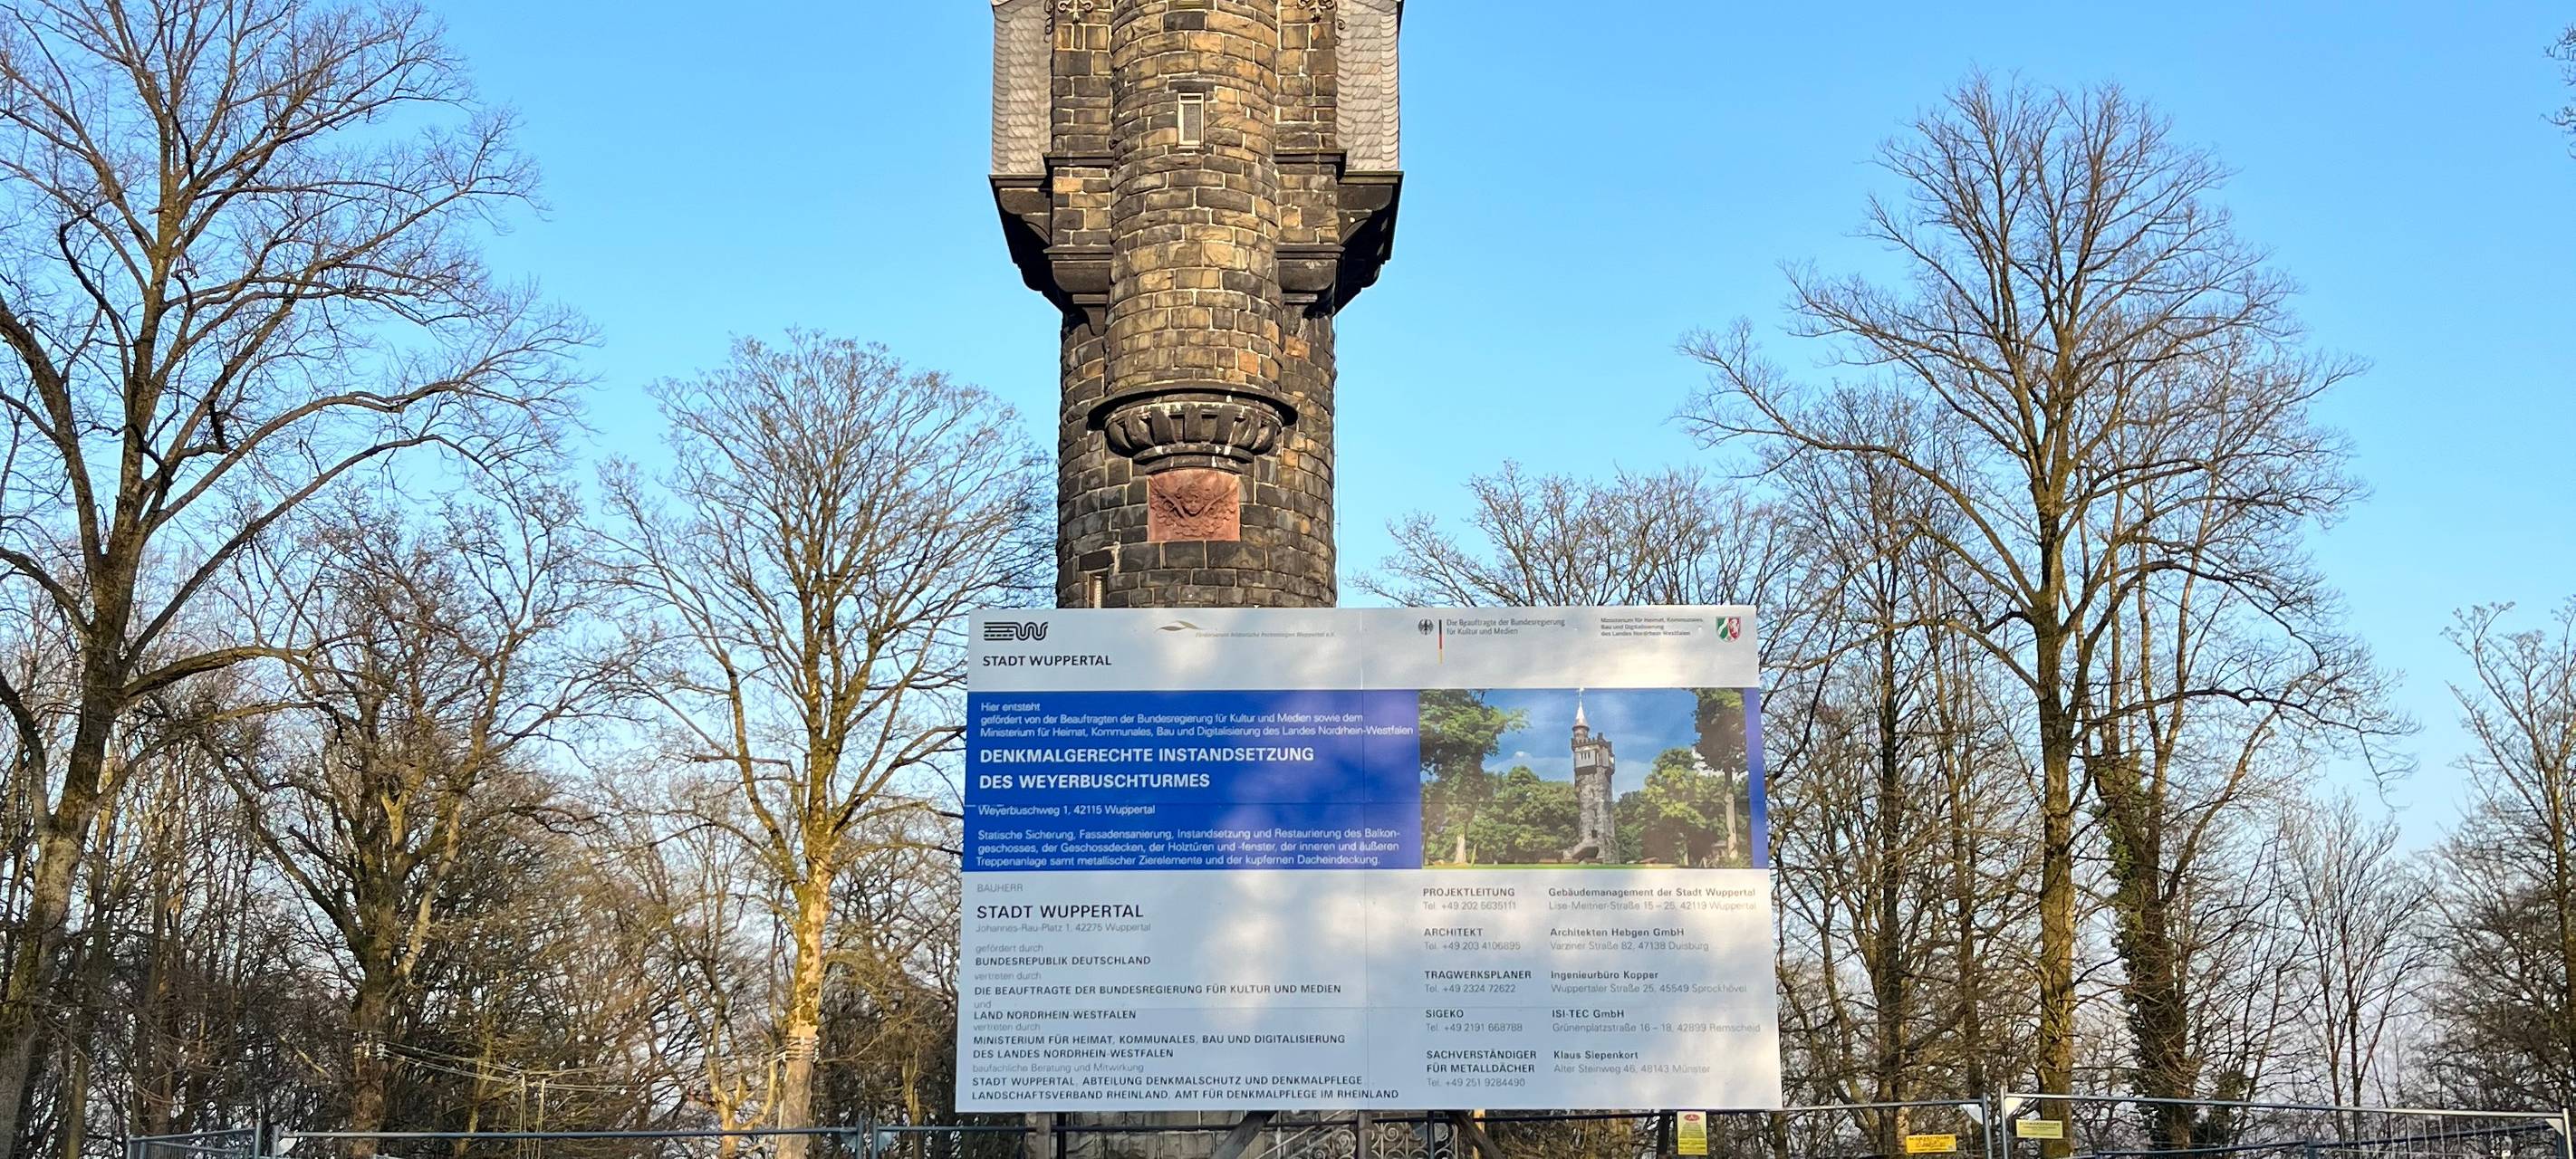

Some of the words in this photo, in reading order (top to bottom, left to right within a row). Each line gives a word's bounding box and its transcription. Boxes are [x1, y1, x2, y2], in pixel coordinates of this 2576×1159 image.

[982, 655, 1025, 667] STADT
[1029, 654, 1113, 666] WUPPERTAL
[980, 703, 1000, 712] Hier
[1001, 703, 1042, 712] entsteht
[980, 714, 1022, 725] gefördert
[1043, 714, 1058, 723] der
[1060, 714, 1118, 725] Beauftragten
[1120, 714, 1134, 723] der
[1137, 714, 1213, 724] Bundesregierung
[1215, 714, 1227, 723] für
[1229, 714, 1255, 723] Kultur
[1257, 714, 1274, 723] und
[1277, 714, 1312, 722] Medien
[1313, 714, 1341, 722] sowie
[1341, 714, 1364, 722] dem
[979, 728, 1035, 737] Ministerium
[1037, 728, 1050, 737] für
[1156, 727, 1175, 736] Bau
[1177, 727, 1195, 736] und
[1197, 726, 1261, 738] Digitalisierung
[1262, 726, 1280, 735] des
[1282, 726, 1316, 735] Landes
[1318, 725, 1415, 735] Nordrhein-Westfalen
[979, 749, 1153, 762] DENKMALGERECHTE
[1158, 748, 1315, 761] INSTANDSETZUNG
[978, 775, 1013, 789] DES
[1018, 774, 1211, 788] WEYERBUSCHTURMES
[977, 805, 1060, 816] Weyerbuschweg
[1072, 805, 1102, 813] 42115
[1104, 805, 1157, 816] Wuppertal
[976, 829, 1023, 838] Statische
[1177, 829, 1251, 839] Instandsetzung
[1253, 829, 1272, 837] und
[1274, 829, 1341, 838] Restaurierung
[1343, 829, 1362, 837] des
[1041, 843, 1057, 851] der
[1149, 842, 1165, 851] der
[1168, 842, 1215, 851] Holztüren
[1216, 842, 1235, 851] und
[1280, 842, 1297, 850] der
[1299, 841, 1335, 850] inneren
[1338, 841, 1356, 850] und
[1359, 841, 1400, 850] äußeren
[976, 857, 1047, 867] Treppenanlage
[1049, 856, 1074, 865] samt
[1076, 856, 1136, 865] metallischer
[1138, 856, 1203, 865] Zierelemente
[1205, 856, 1224, 864] und
[1226, 855, 1243, 864] der
[1245, 855, 1294, 866] kupfernen
[1297, 855, 1381, 866] Dacheindeckung.
[976, 884, 1024, 893] BAUHERR
[1422, 887, 1516, 896] PROJEKTLEITUNG
[1548, 887, 1653, 897] Gebäudemanagement
[1657, 887, 1672, 896] der
[1676, 887, 1702, 896] Stadt
[1705, 887, 1756, 897] Wuppertal
[976, 905, 1033, 918] STADT
[1040, 905, 1145, 918] WUPPERTAL
[1074, 923, 1102, 931] 42275
[1104, 923, 1152, 933] Wuppertal
[1423, 928, 1484, 936] ARCHITEKT
[1610, 928, 1649, 937] Hebgen
[975, 943, 1016, 953] gefördert
[1018, 943, 1044, 952] durch
[975, 957, 1068, 965] BUNDESREPUBLIK
[1072, 956, 1152, 965] DEUTSCHLAND
[974, 972, 1014, 980] vertreten
[1015, 972, 1043, 980] durch
[1424, 971, 1533, 979] TRAGWERKSPLANER
[1551, 971, 1620, 981] Ingenieurbüro
[1623, 971, 1659, 981] Kopper
[974, 987, 991, 995] DIE
[995, 987, 1071, 995] BEAUFTRAGTE
[1074, 986, 1096, 995] DER
[1099, 986, 1202, 994] BUNDESREGIERUNG
[1206, 984, 1226, 994] FÜR
[1229, 985, 1270, 994] KULTUR
[1274, 985, 1297, 993] UND
[1300, 985, 1342, 993] MEDIEN
[1442, 984, 1461, 992] +49
[1463, 984, 1485, 992] 2324
[1488, 984, 1516, 992] 72622
[1551, 984, 1607, 994] Wuppertaler
[1610, 984, 1639, 992] Straße
[973, 1000, 992, 1009] und
[973, 1011, 1004, 1019] LAND
[1006, 1011, 1137, 1019] NORDRHEIN-WESTFALEN
[1425, 1010, 1465, 1018] SIGEKO
[1592, 1010, 1625, 1018] GmbH
[973, 1023, 1014, 1031] vertreten
[1014, 1023, 1042, 1031] durch
[973, 1036, 1044, 1045] MINISTERIUM
[1048, 1034, 1069, 1045] FÜR
[1202, 1035, 1224, 1044] BAU
[1227, 1035, 1251, 1044] UND
[1254, 1035, 1346, 1044] DIGITALISIERUNG
[972, 1049, 994, 1058] DES
[997, 1049, 1040, 1058] LANDES
[1043, 1049, 1175, 1057] NORDRHEIN-WESTFALEN
[1426, 1049, 1537, 1059] SACHVERSTÄNDIGER
[1553, 1050, 1581, 1058] Klaus
[972, 1063, 1028, 1071] baufachliche
[1031, 1063, 1072, 1073] Beratung
[1073, 1063, 1091, 1071] und
[1093, 1063, 1145, 1073] Mitwirkung
[1426, 1063, 1447, 1072] FÜR
[1450, 1063, 1536, 1072] METALLDÄCHER
[972, 1078, 1006, 1086] STADT
[1081, 1077, 1142, 1086] ABTEILUNG
[1146, 1077, 1241, 1085] DENKMALSCHUTZ
[1245, 1077, 1268, 1085] UND
[1272, 1076, 1363, 1085] DENKMALPFLEGE
[971, 1091, 1102, 1099] LANDSCHAFTSVERBAND
[1174, 1090, 1198, 1099] AMT
[1202, 1089, 1223, 1099] FÜR
[1226, 1090, 1316, 1098] DENKMALPFLEGE
[1321, 1090, 1333, 1098] IM
[1337, 1090, 1399, 1098] RHEINLAND
